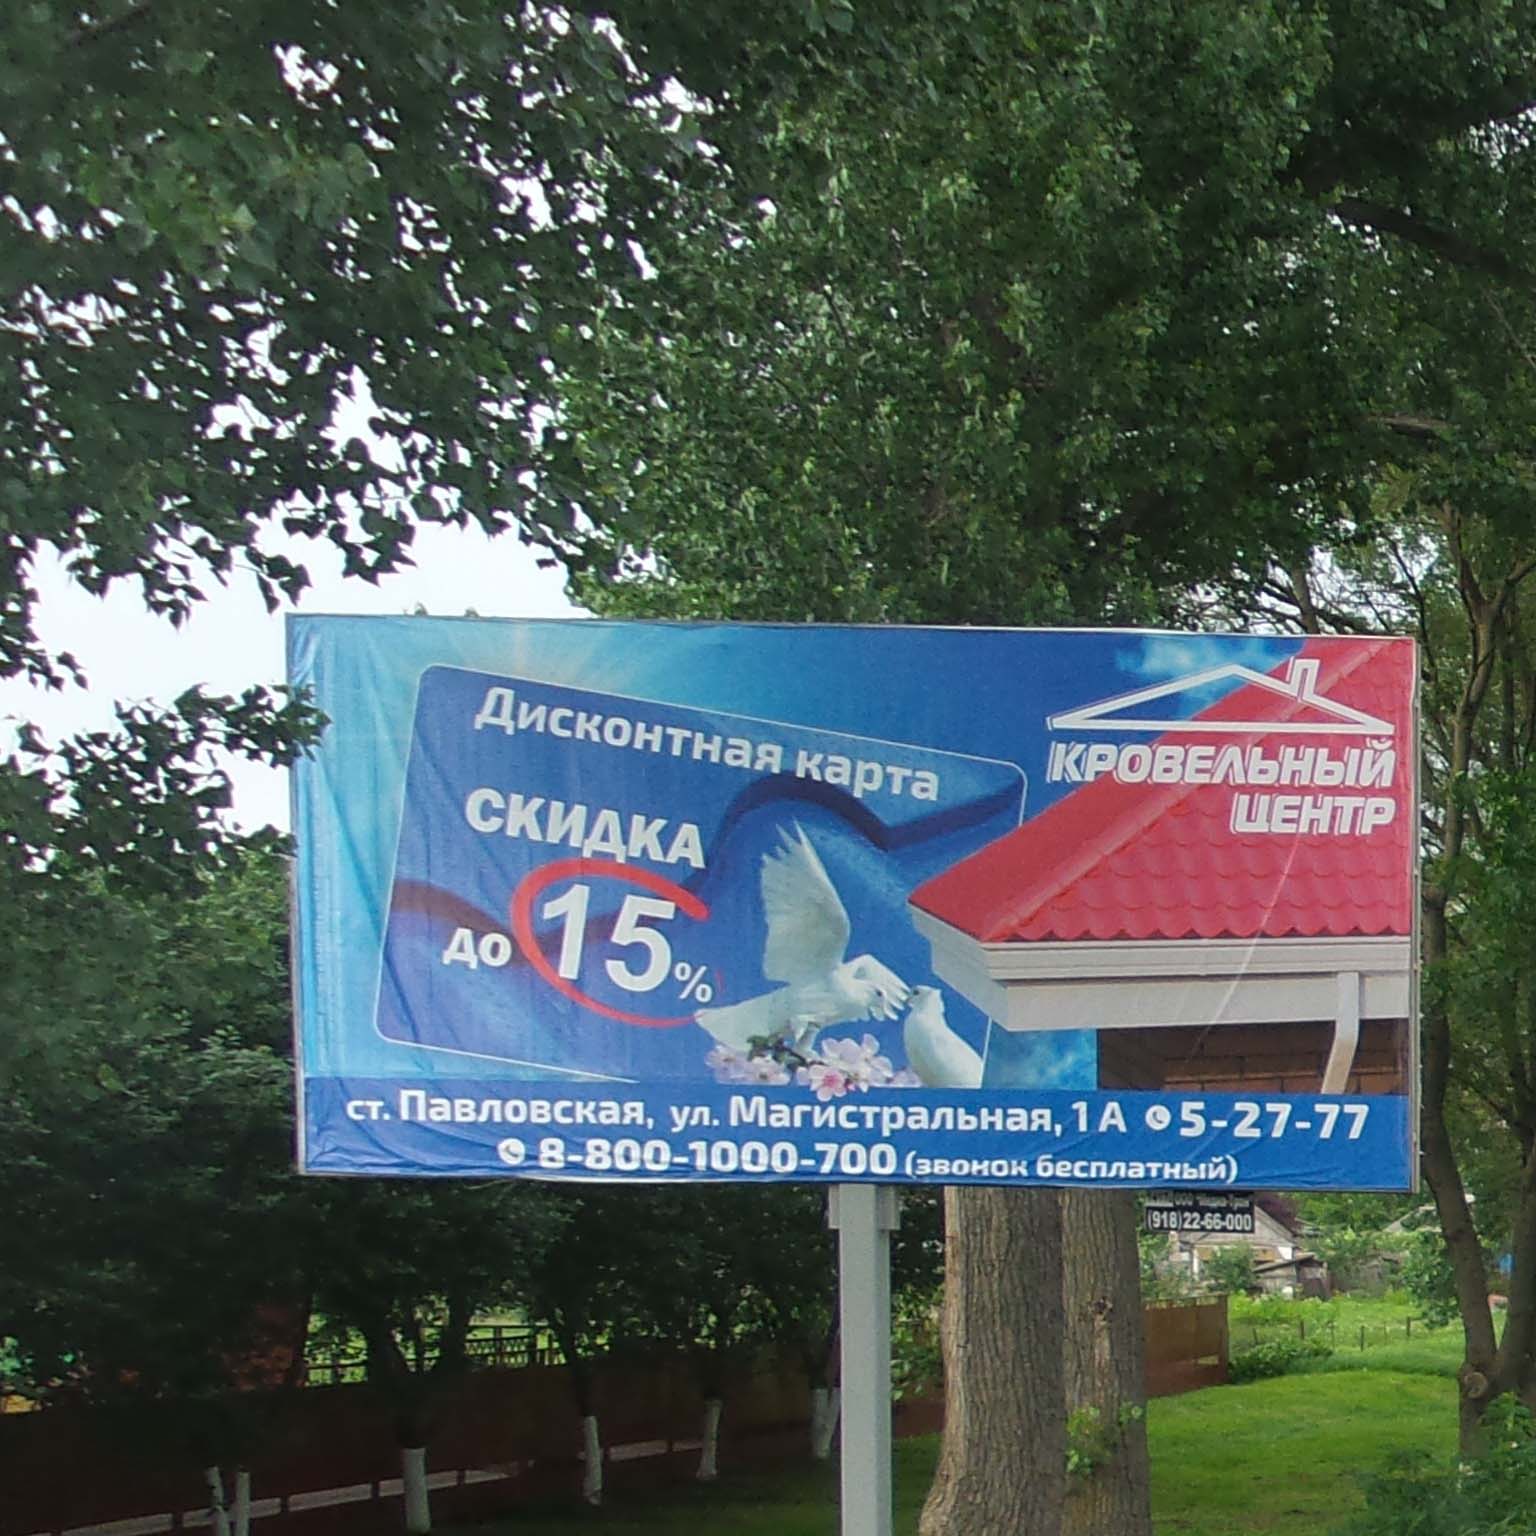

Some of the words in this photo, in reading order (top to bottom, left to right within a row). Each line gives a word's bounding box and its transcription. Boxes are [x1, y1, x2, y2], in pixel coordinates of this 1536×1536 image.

[474, 686, 783, 774] Дисконтная
[796, 749, 939, 801] карта
[1047, 737, 1396, 786] КРОВЕЛЬНЫЙ
[465, 788, 706, 869] СКИДКА
[1231, 793, 1396, 835] ЦЕНТР
[346, 1098, 390, 1121] ст.
[400, 1089, 655, 1130] Павловская,
[670, 1104, 720, 1132] ул.
[730, 1096, 1063, 1138] Магистральная,
[1179, 1102, 1370, 1139] 5-27-77
[538, 1137, 897, 1175] 8-800-1000-700
[904, 1150, 1029, 1180] (звонок
[1036, 1151, 1238, 1184] бесплатный)
[1147, 1209, 1253, 1232] (918)22-66-000
